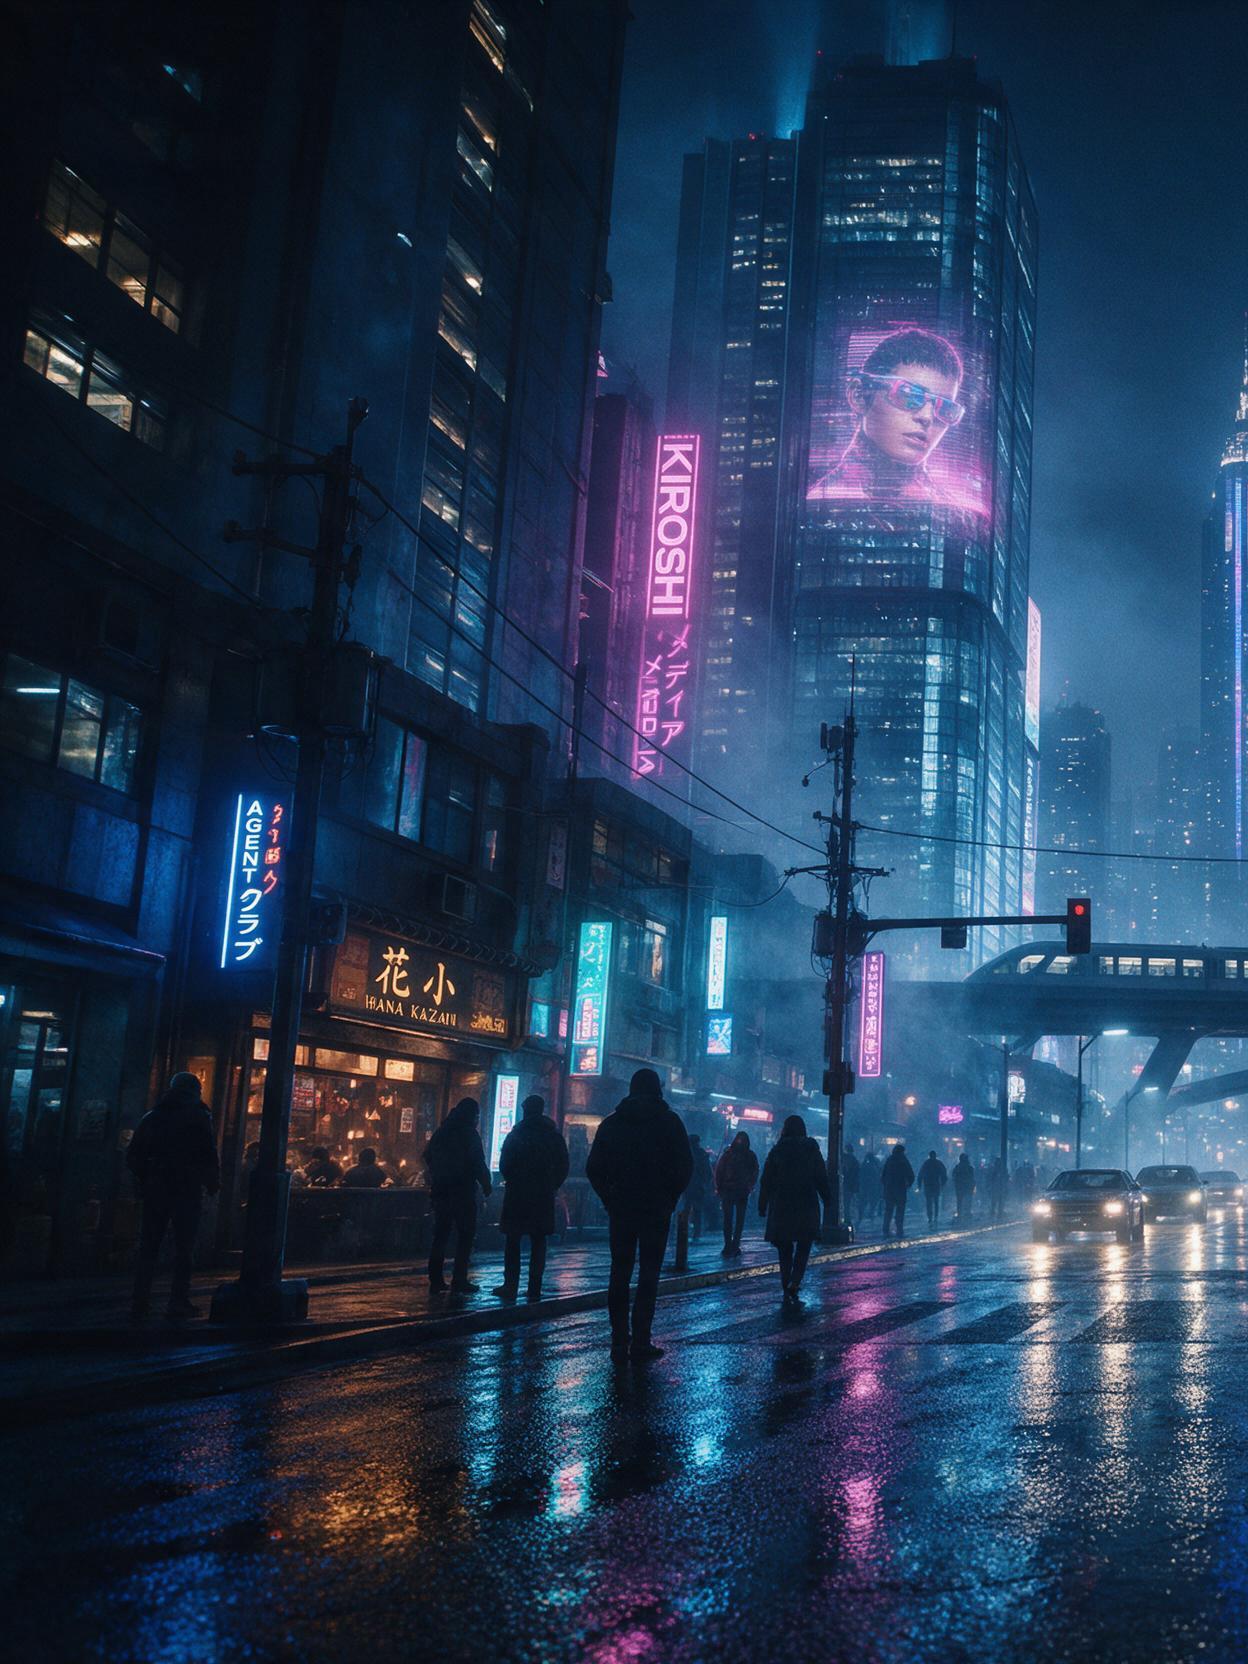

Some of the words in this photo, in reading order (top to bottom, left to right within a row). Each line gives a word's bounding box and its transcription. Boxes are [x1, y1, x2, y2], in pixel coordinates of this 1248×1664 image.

[652, 443, 694, 616] KIROSHI
[242, 800, 264, 884] AGENT
[234, 888, 264, 961] クラブ
[375, 945, 456, 1006] 花小
